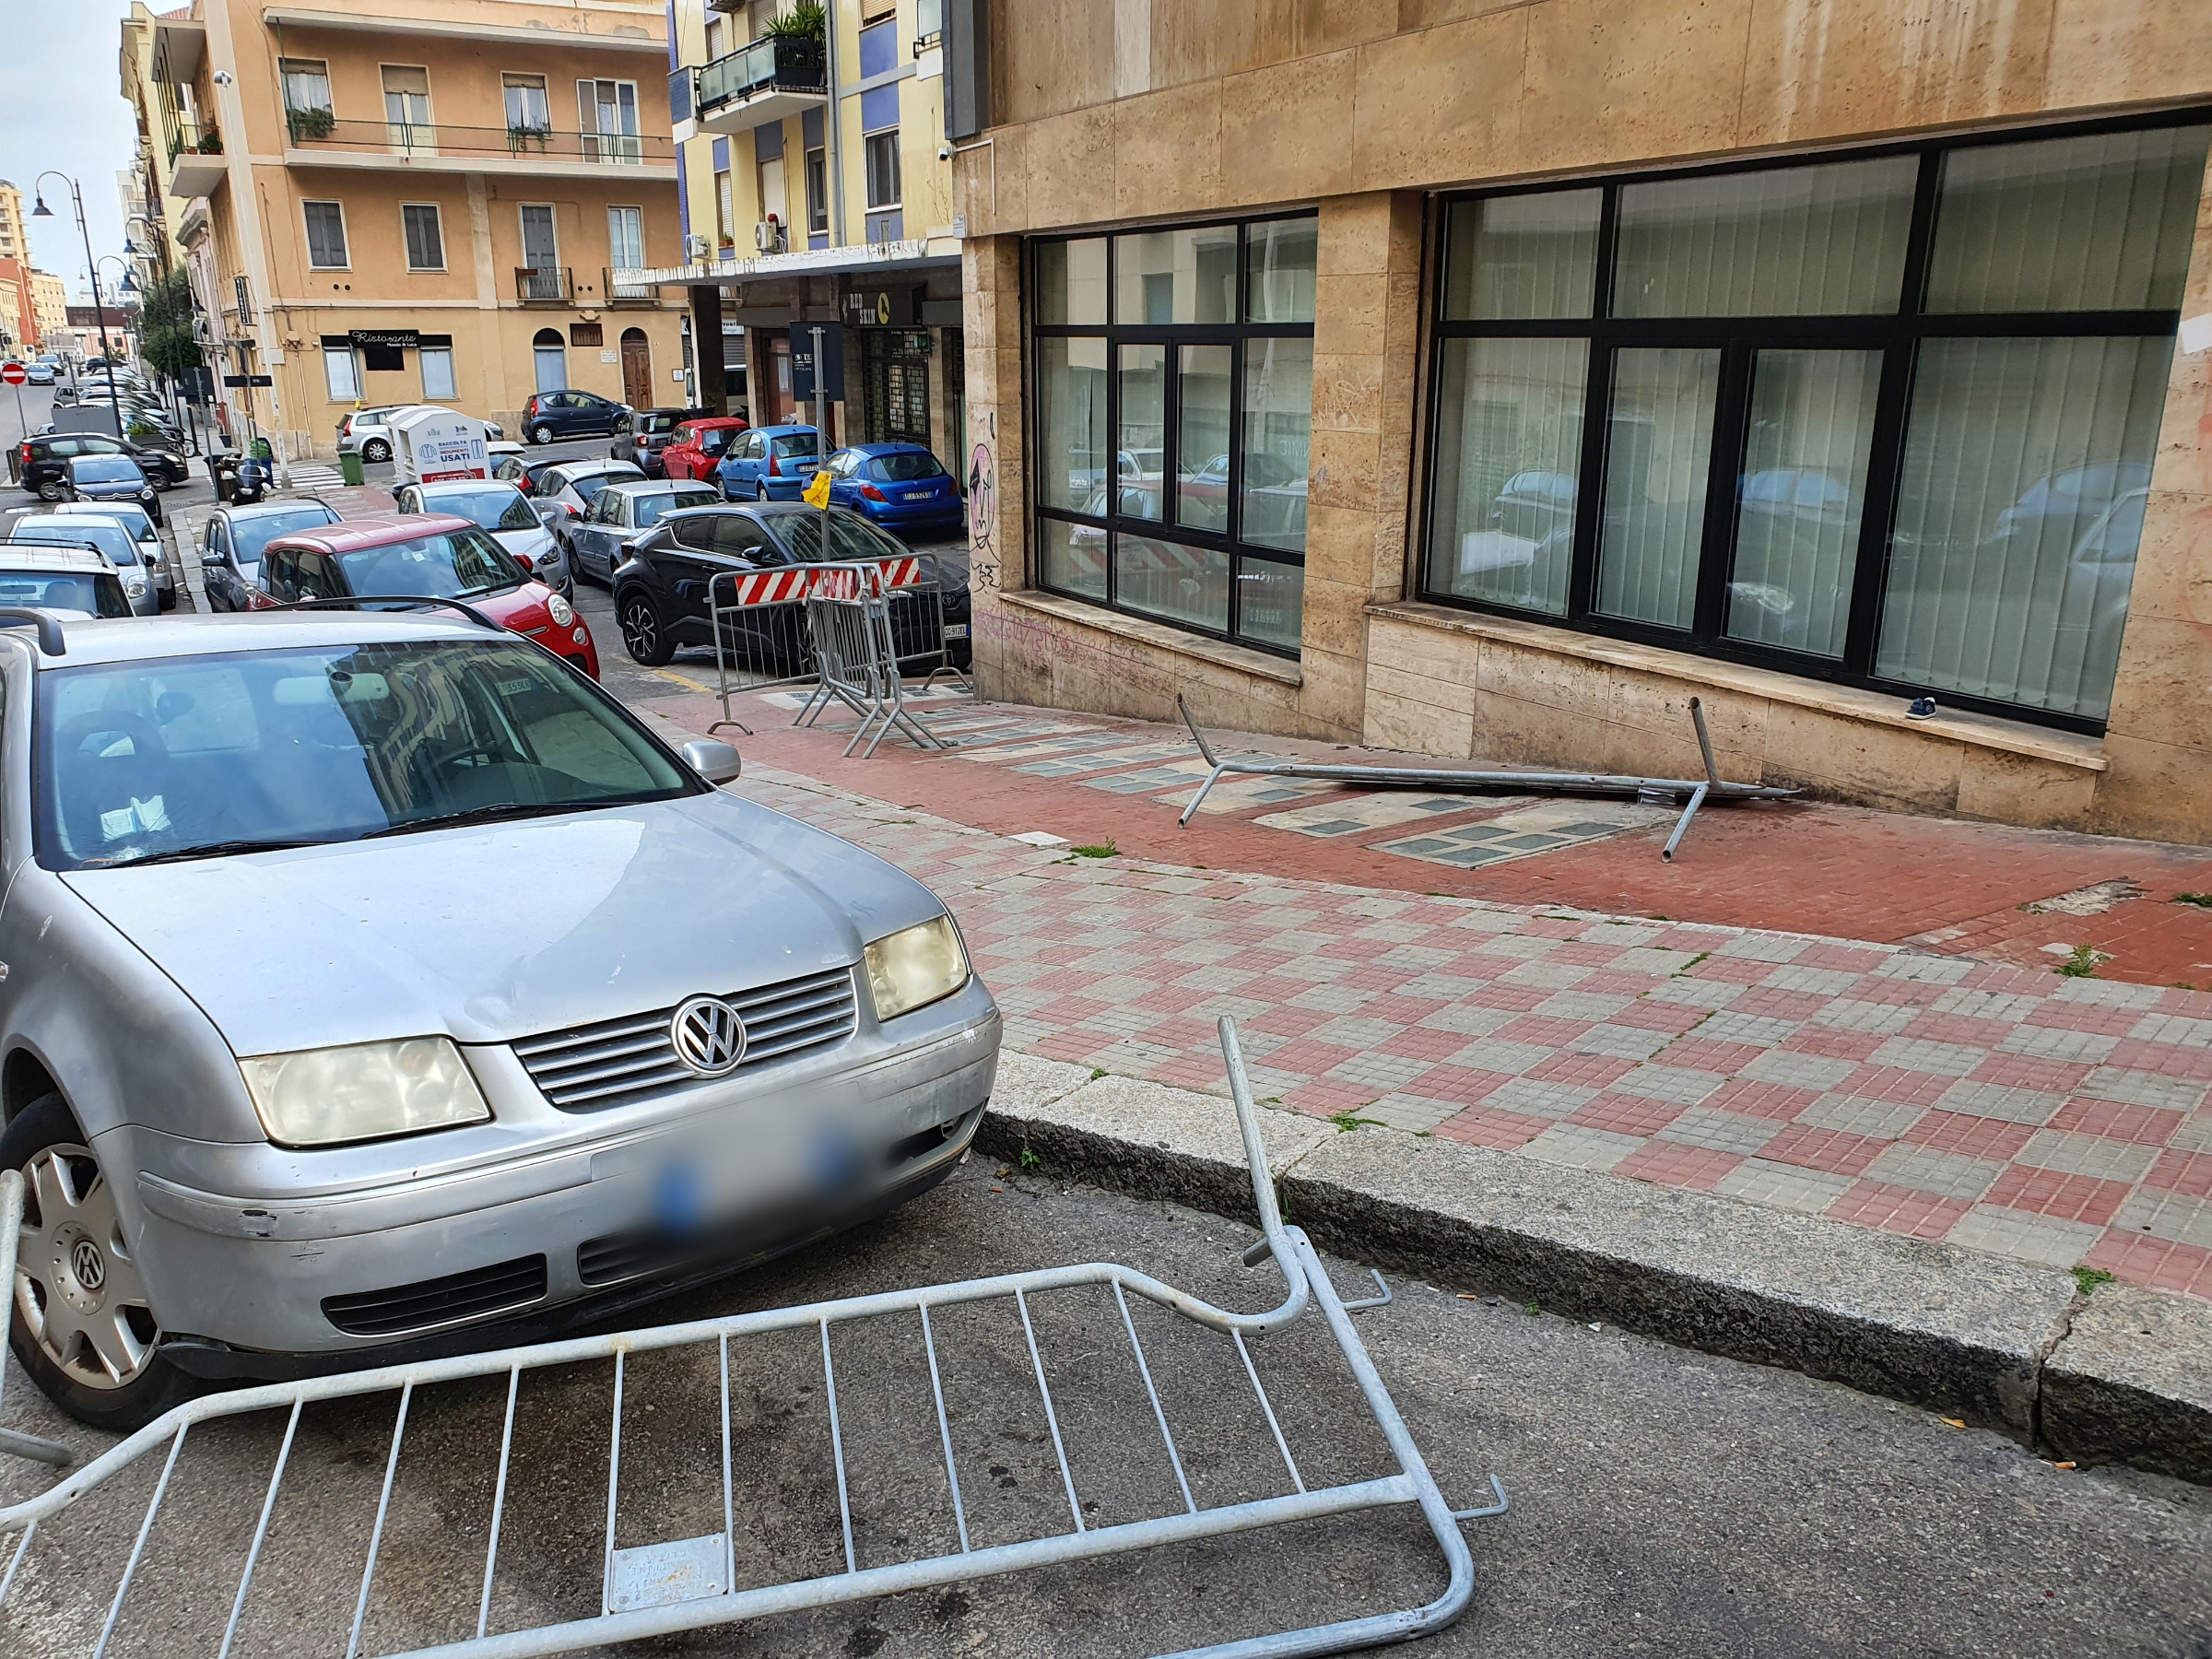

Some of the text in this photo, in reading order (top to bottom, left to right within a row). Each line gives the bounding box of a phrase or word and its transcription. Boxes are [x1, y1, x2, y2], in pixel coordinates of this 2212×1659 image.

[850, 293, 863, 309] RED
[859, 309, 876, 324] SKIN
[352, 331, 417, 343] Ristorante
[441, 453, 470, 462] USATI
